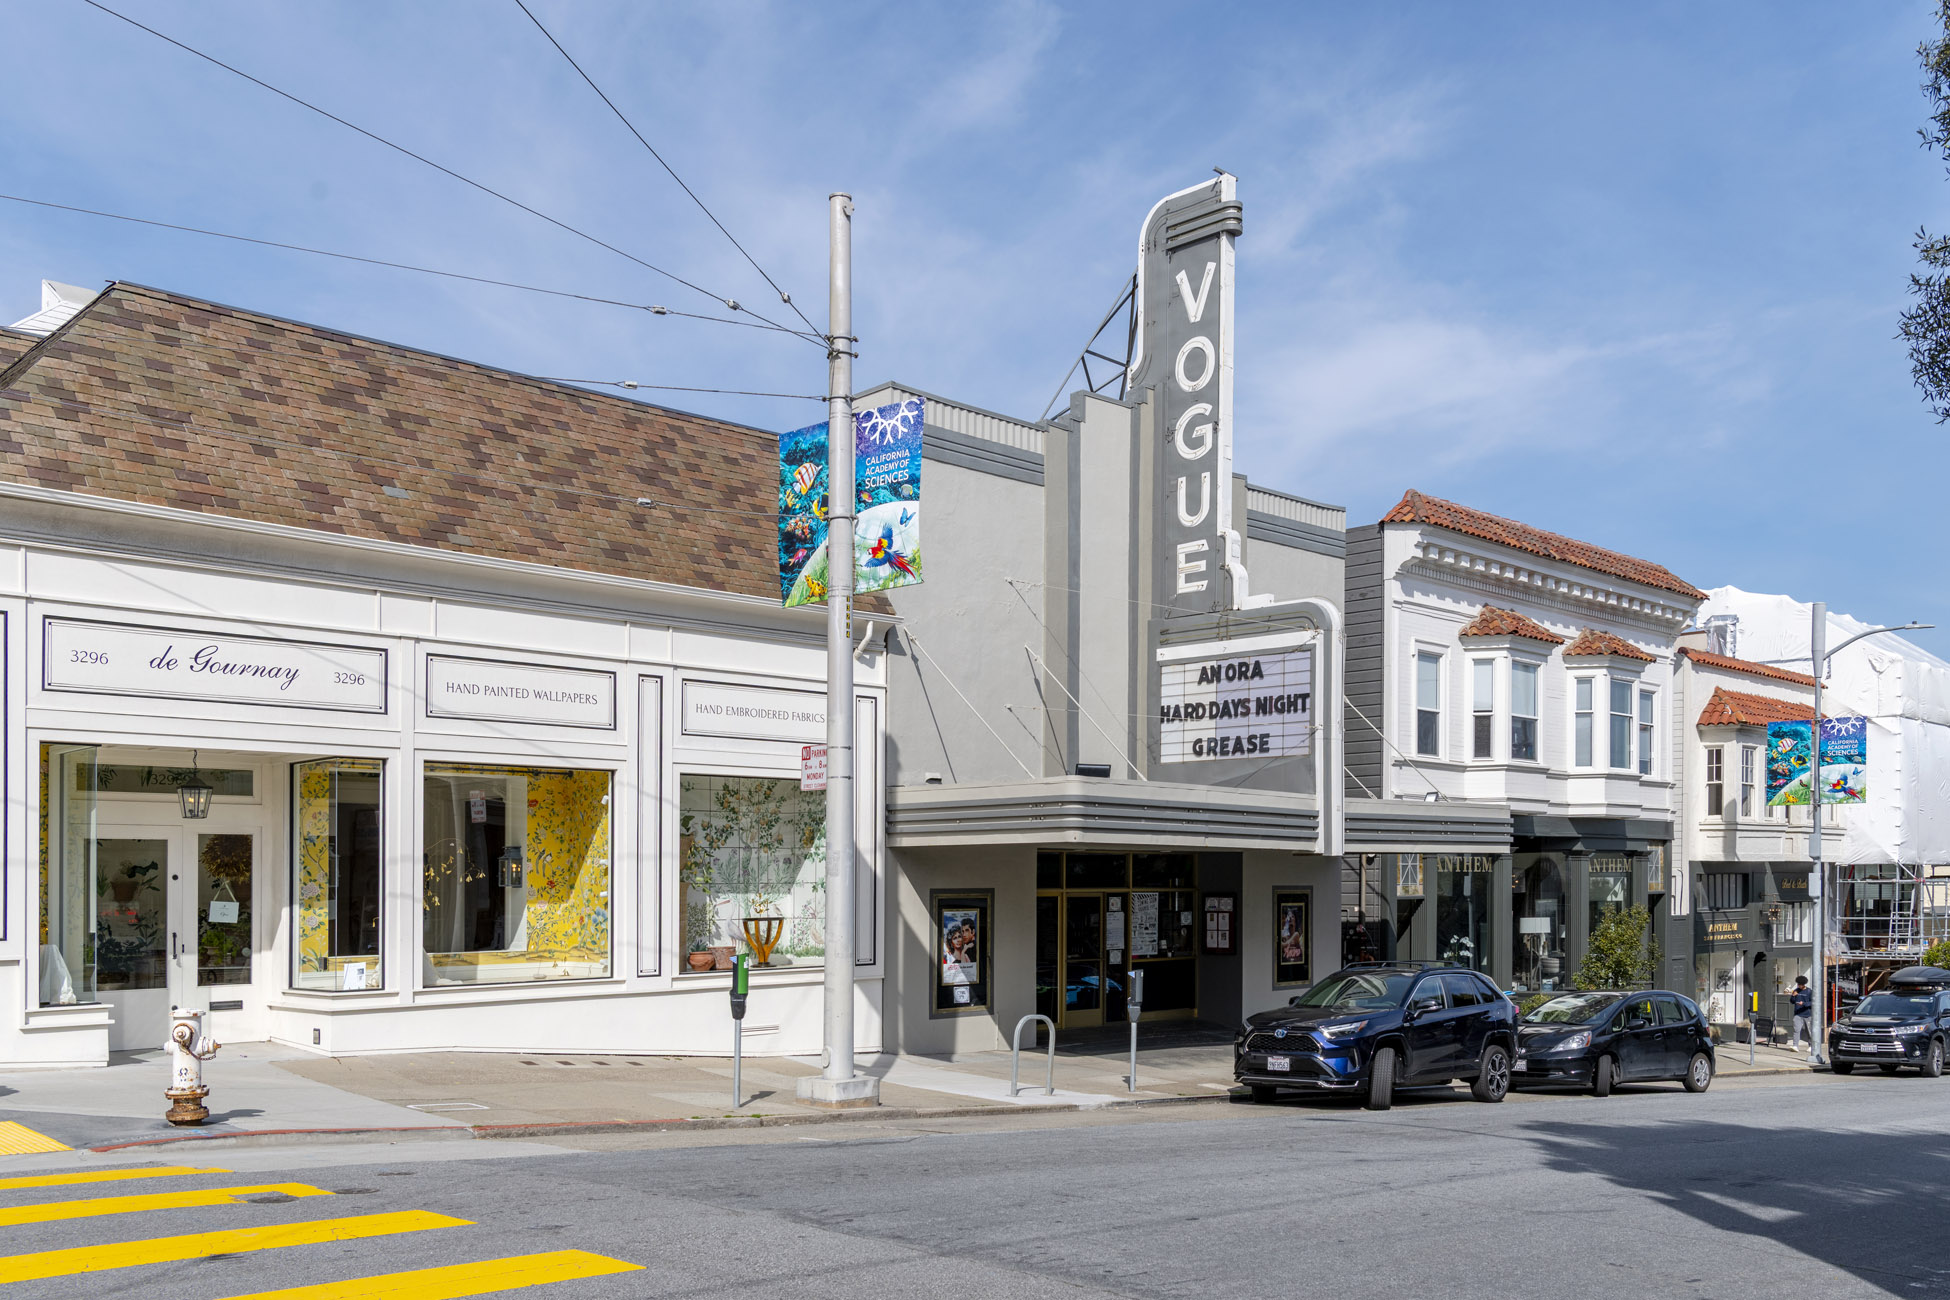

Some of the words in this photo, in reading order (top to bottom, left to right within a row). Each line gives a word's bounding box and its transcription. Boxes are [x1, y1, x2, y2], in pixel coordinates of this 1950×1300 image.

[1174, 261, 1217, 595] VOGUE
[865, 448, 910, 466] CALIFORNIA
[865, 460, 899, 476] ACADEMY
[899, 458, 910, 469] OF
[865, 468, 910, 489] SCIENCES
[70, 649, 109, 665] 3296
[149, 645, 179, 671] de
[189, 645, 300, 691] Gournay
[333, 671, 366, 686] 3296
[1197, 660, 1264, 686] ANORA
[446, 682, 480, 695] HAND
[484, 685, 530, 699] PAINTED
[533, 689, 598, 705] WALLPAPERS
[695, 703, 723, 715] HAND
[725, 705, 790, 721] EMBROIDERED
[791, 711, 826, 723] FABRICS
[1160, 702, 1207, 724] HARD
[1208, 698, 1251, 720] DAYS
[1255, 693, 1310, 716] NIGHT
[812, 749, 827, 758] PARKIN
[1192, 733, 1271, 757] GREASE
[1436, 855, 1493, 873] ANTHEM
[1708, 922, 1738, 933] ANTHEM
